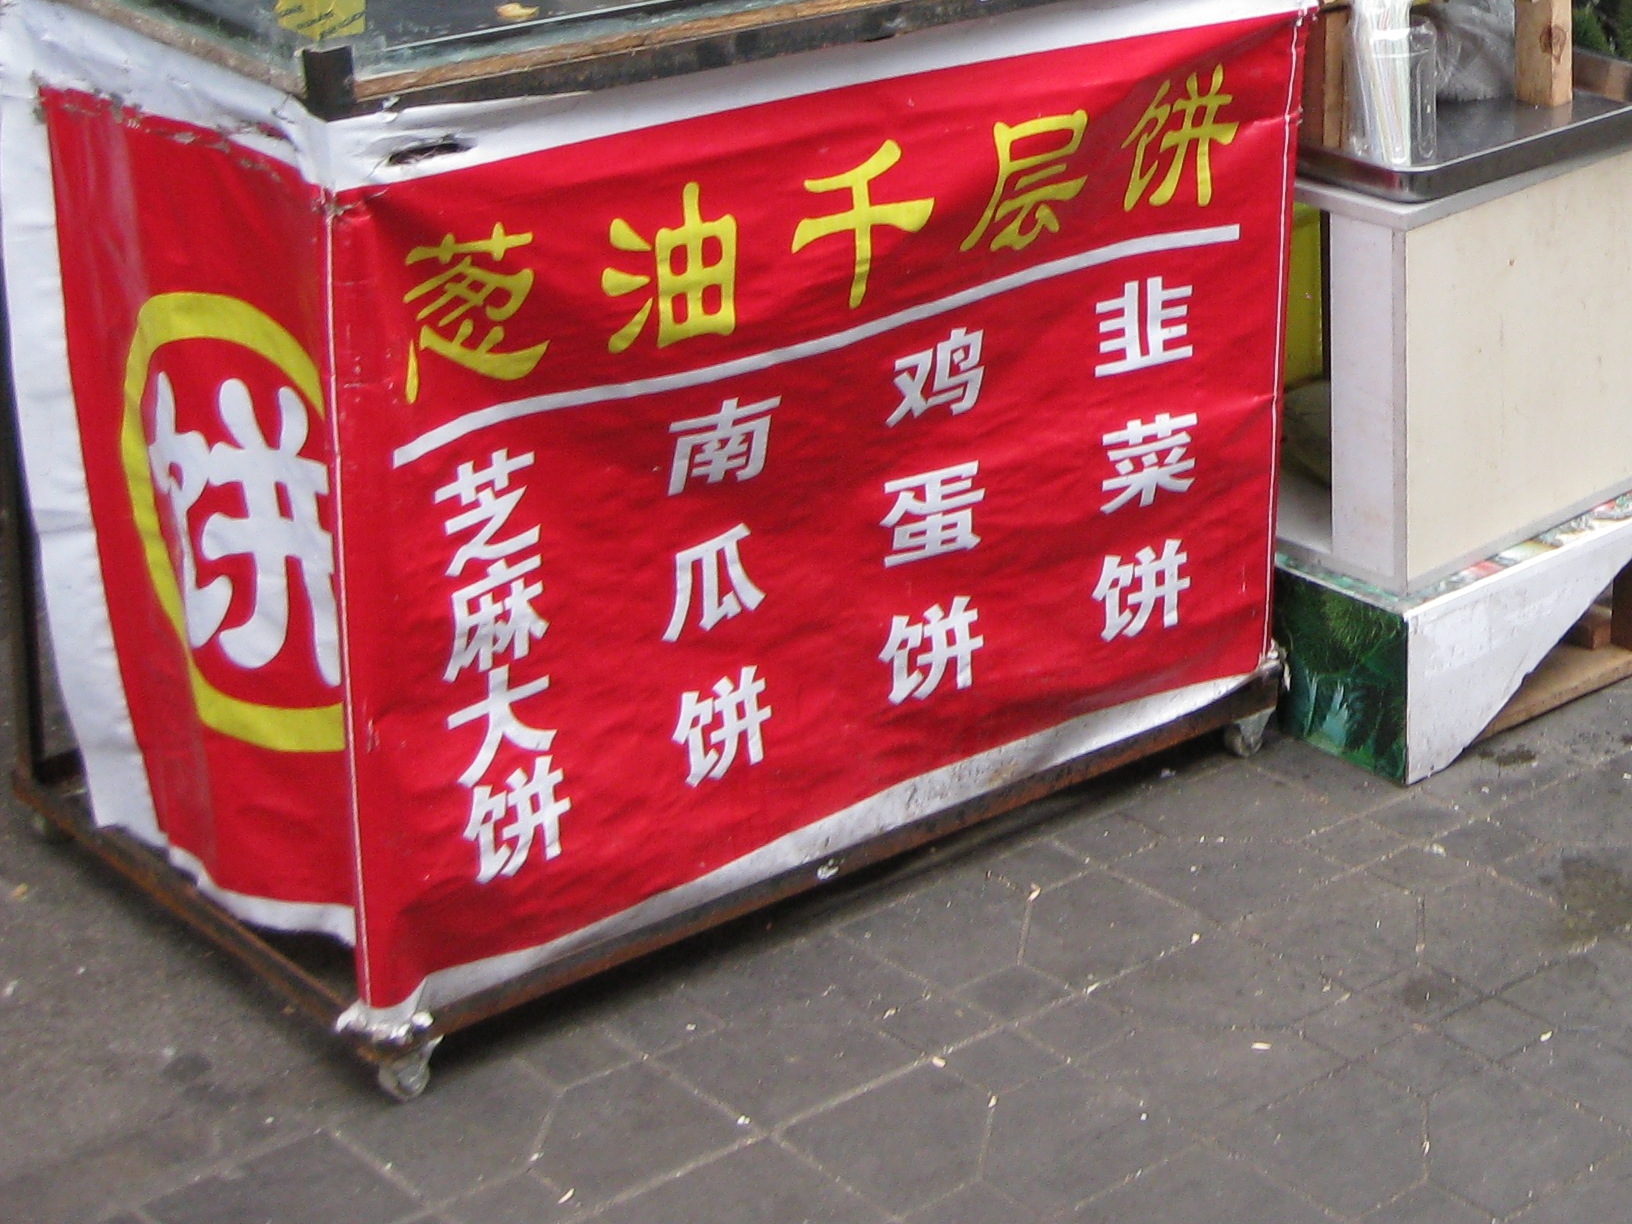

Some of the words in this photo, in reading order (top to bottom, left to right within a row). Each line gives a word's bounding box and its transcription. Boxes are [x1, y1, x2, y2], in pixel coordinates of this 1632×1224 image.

[403, 61, 1240, 404] 葱油千层饼
[149, 370, 343, 688] 饼
[662, 393, 782, 788] 南瓜饼
[878, 325, 988, 706] 鸡蛋饼
[1091, 273, 1200, 644] 韭菜饼
[433, 448, 573, 885] 芝麻大饼
